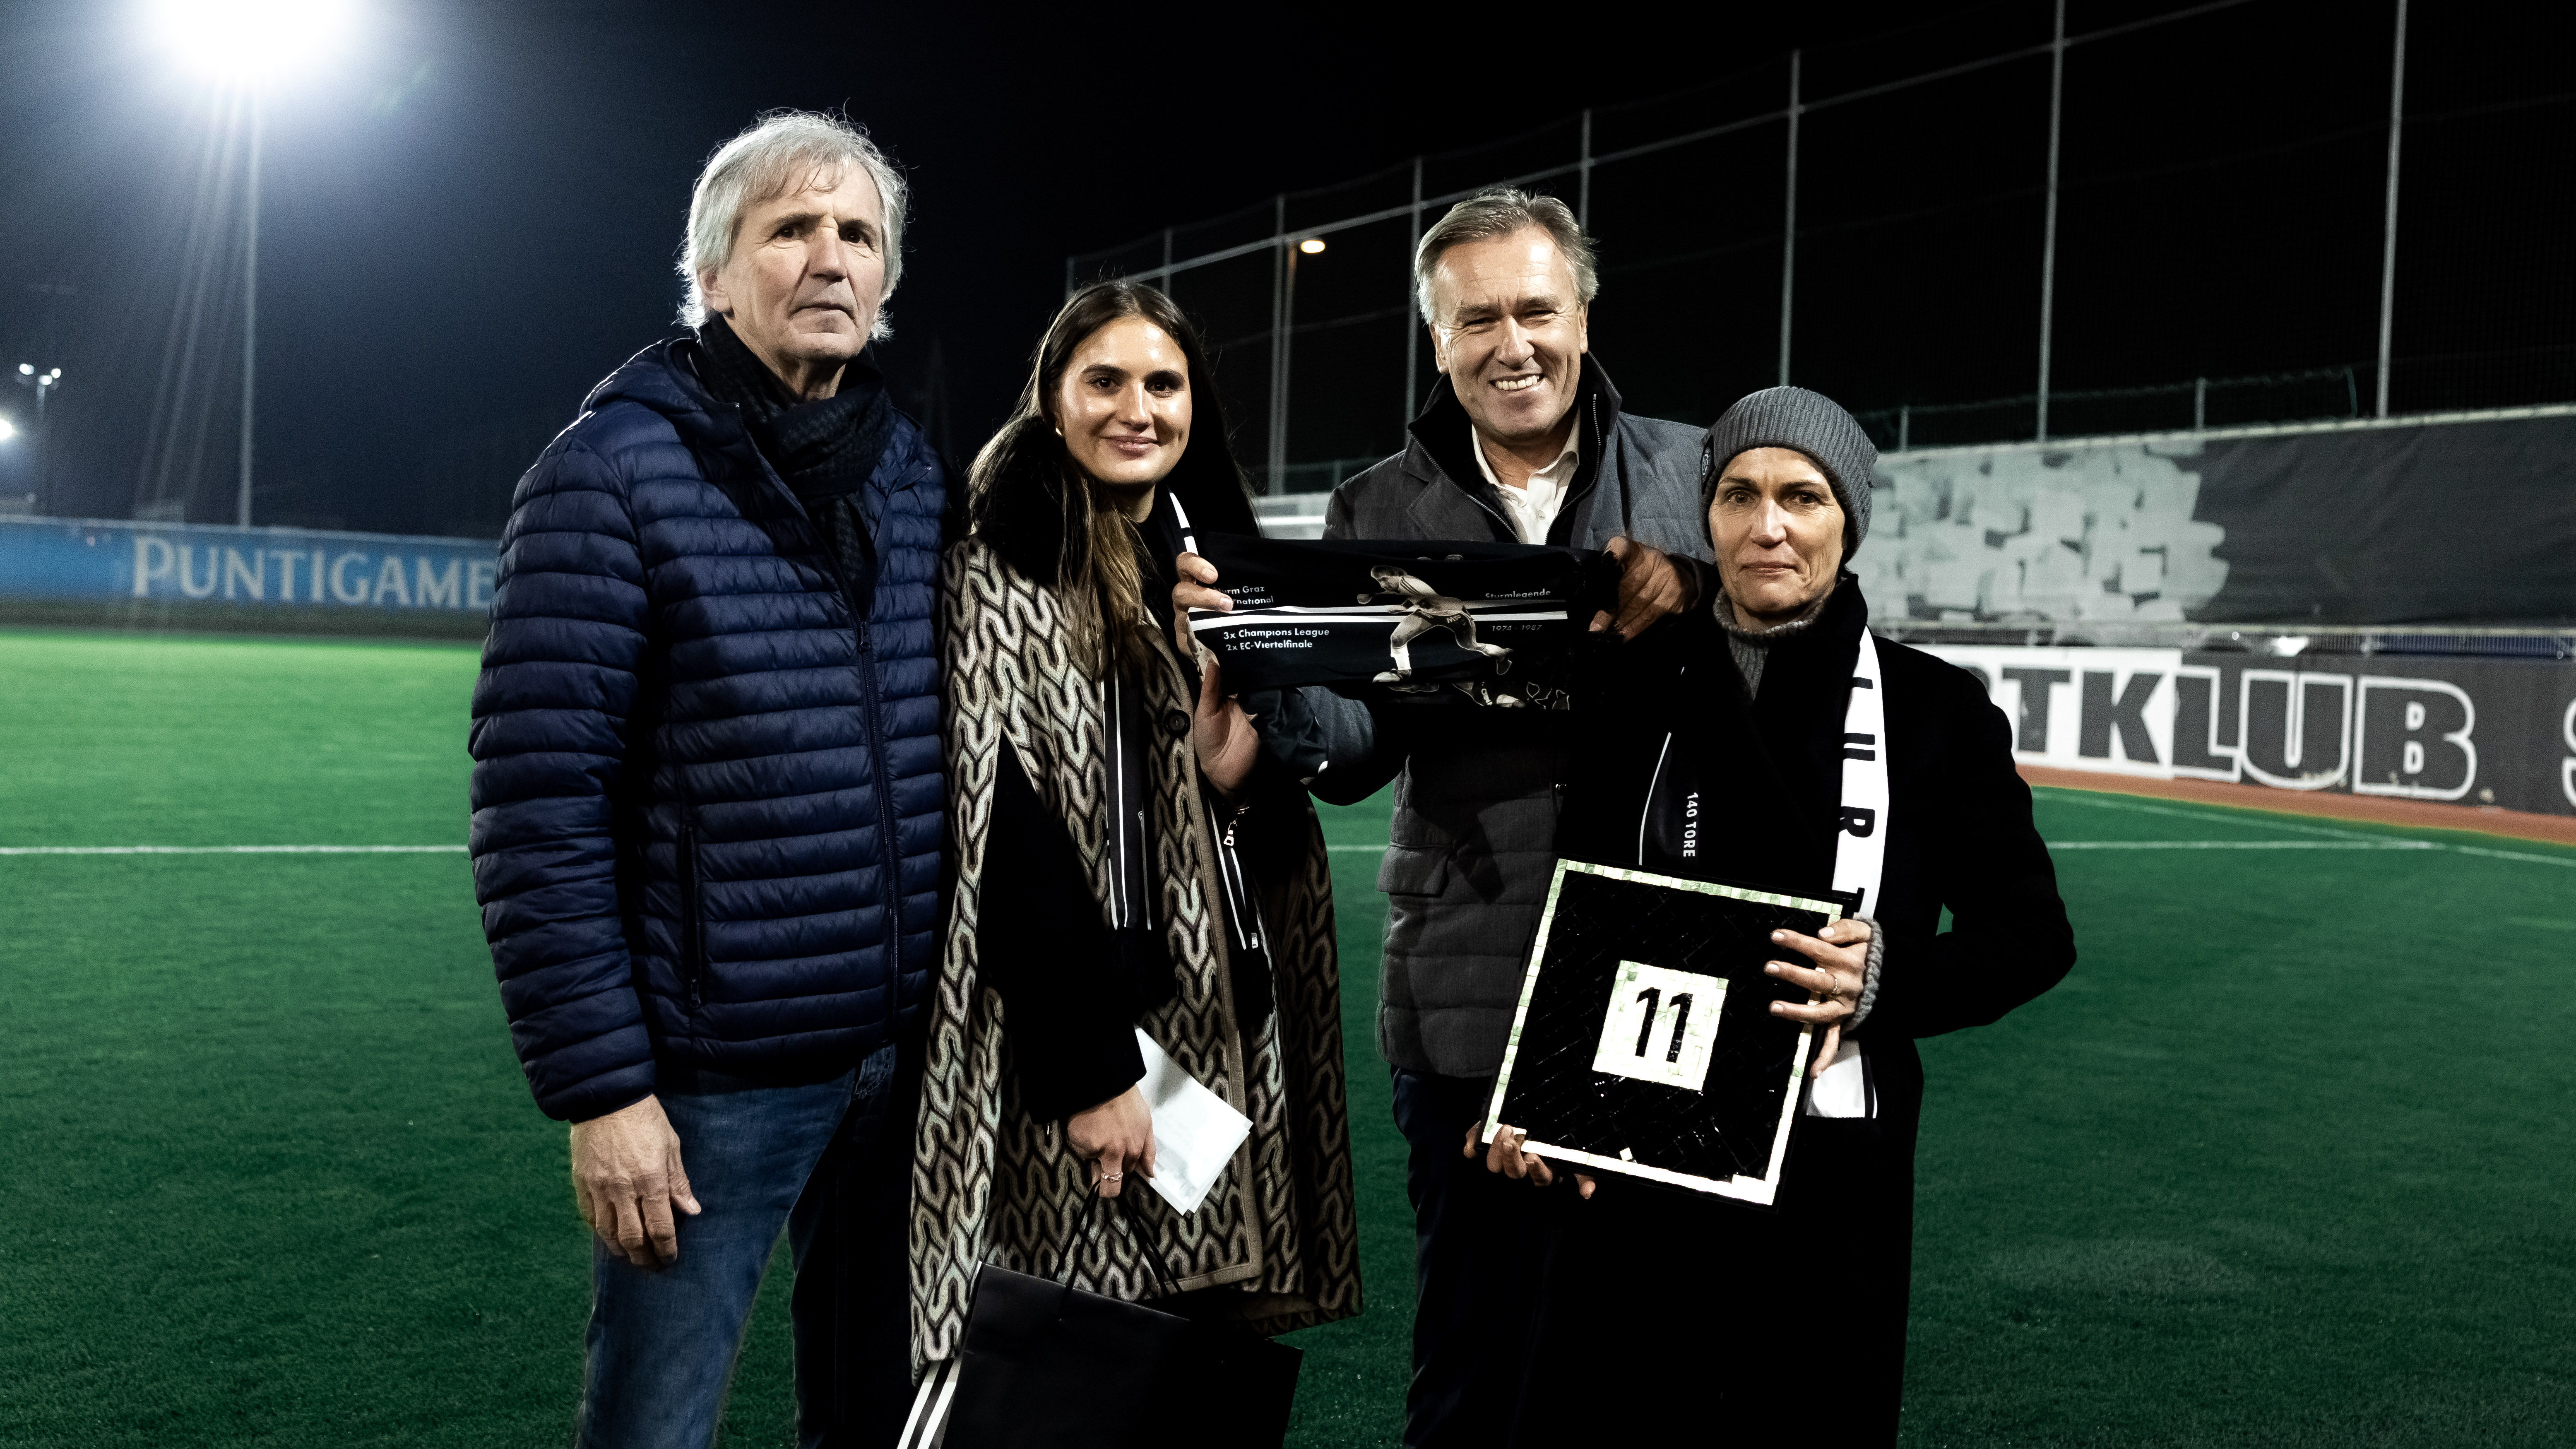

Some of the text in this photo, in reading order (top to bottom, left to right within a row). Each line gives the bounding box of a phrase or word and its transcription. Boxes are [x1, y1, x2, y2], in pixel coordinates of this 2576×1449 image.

[133, 536, 495, 609] PUNTIGAME
[1485, 588, 1551, 599] Sturmlegende
[1223, 628, 1330, 640] 3x Champions League
[1239, 640, 1313, 650] EC-Viertelfinale
[1961, 663, 2477, 801] TKLUB
[1683, 792, 1698, 857] 140 TORE
[1636, 987, 1693, 1063] 11
